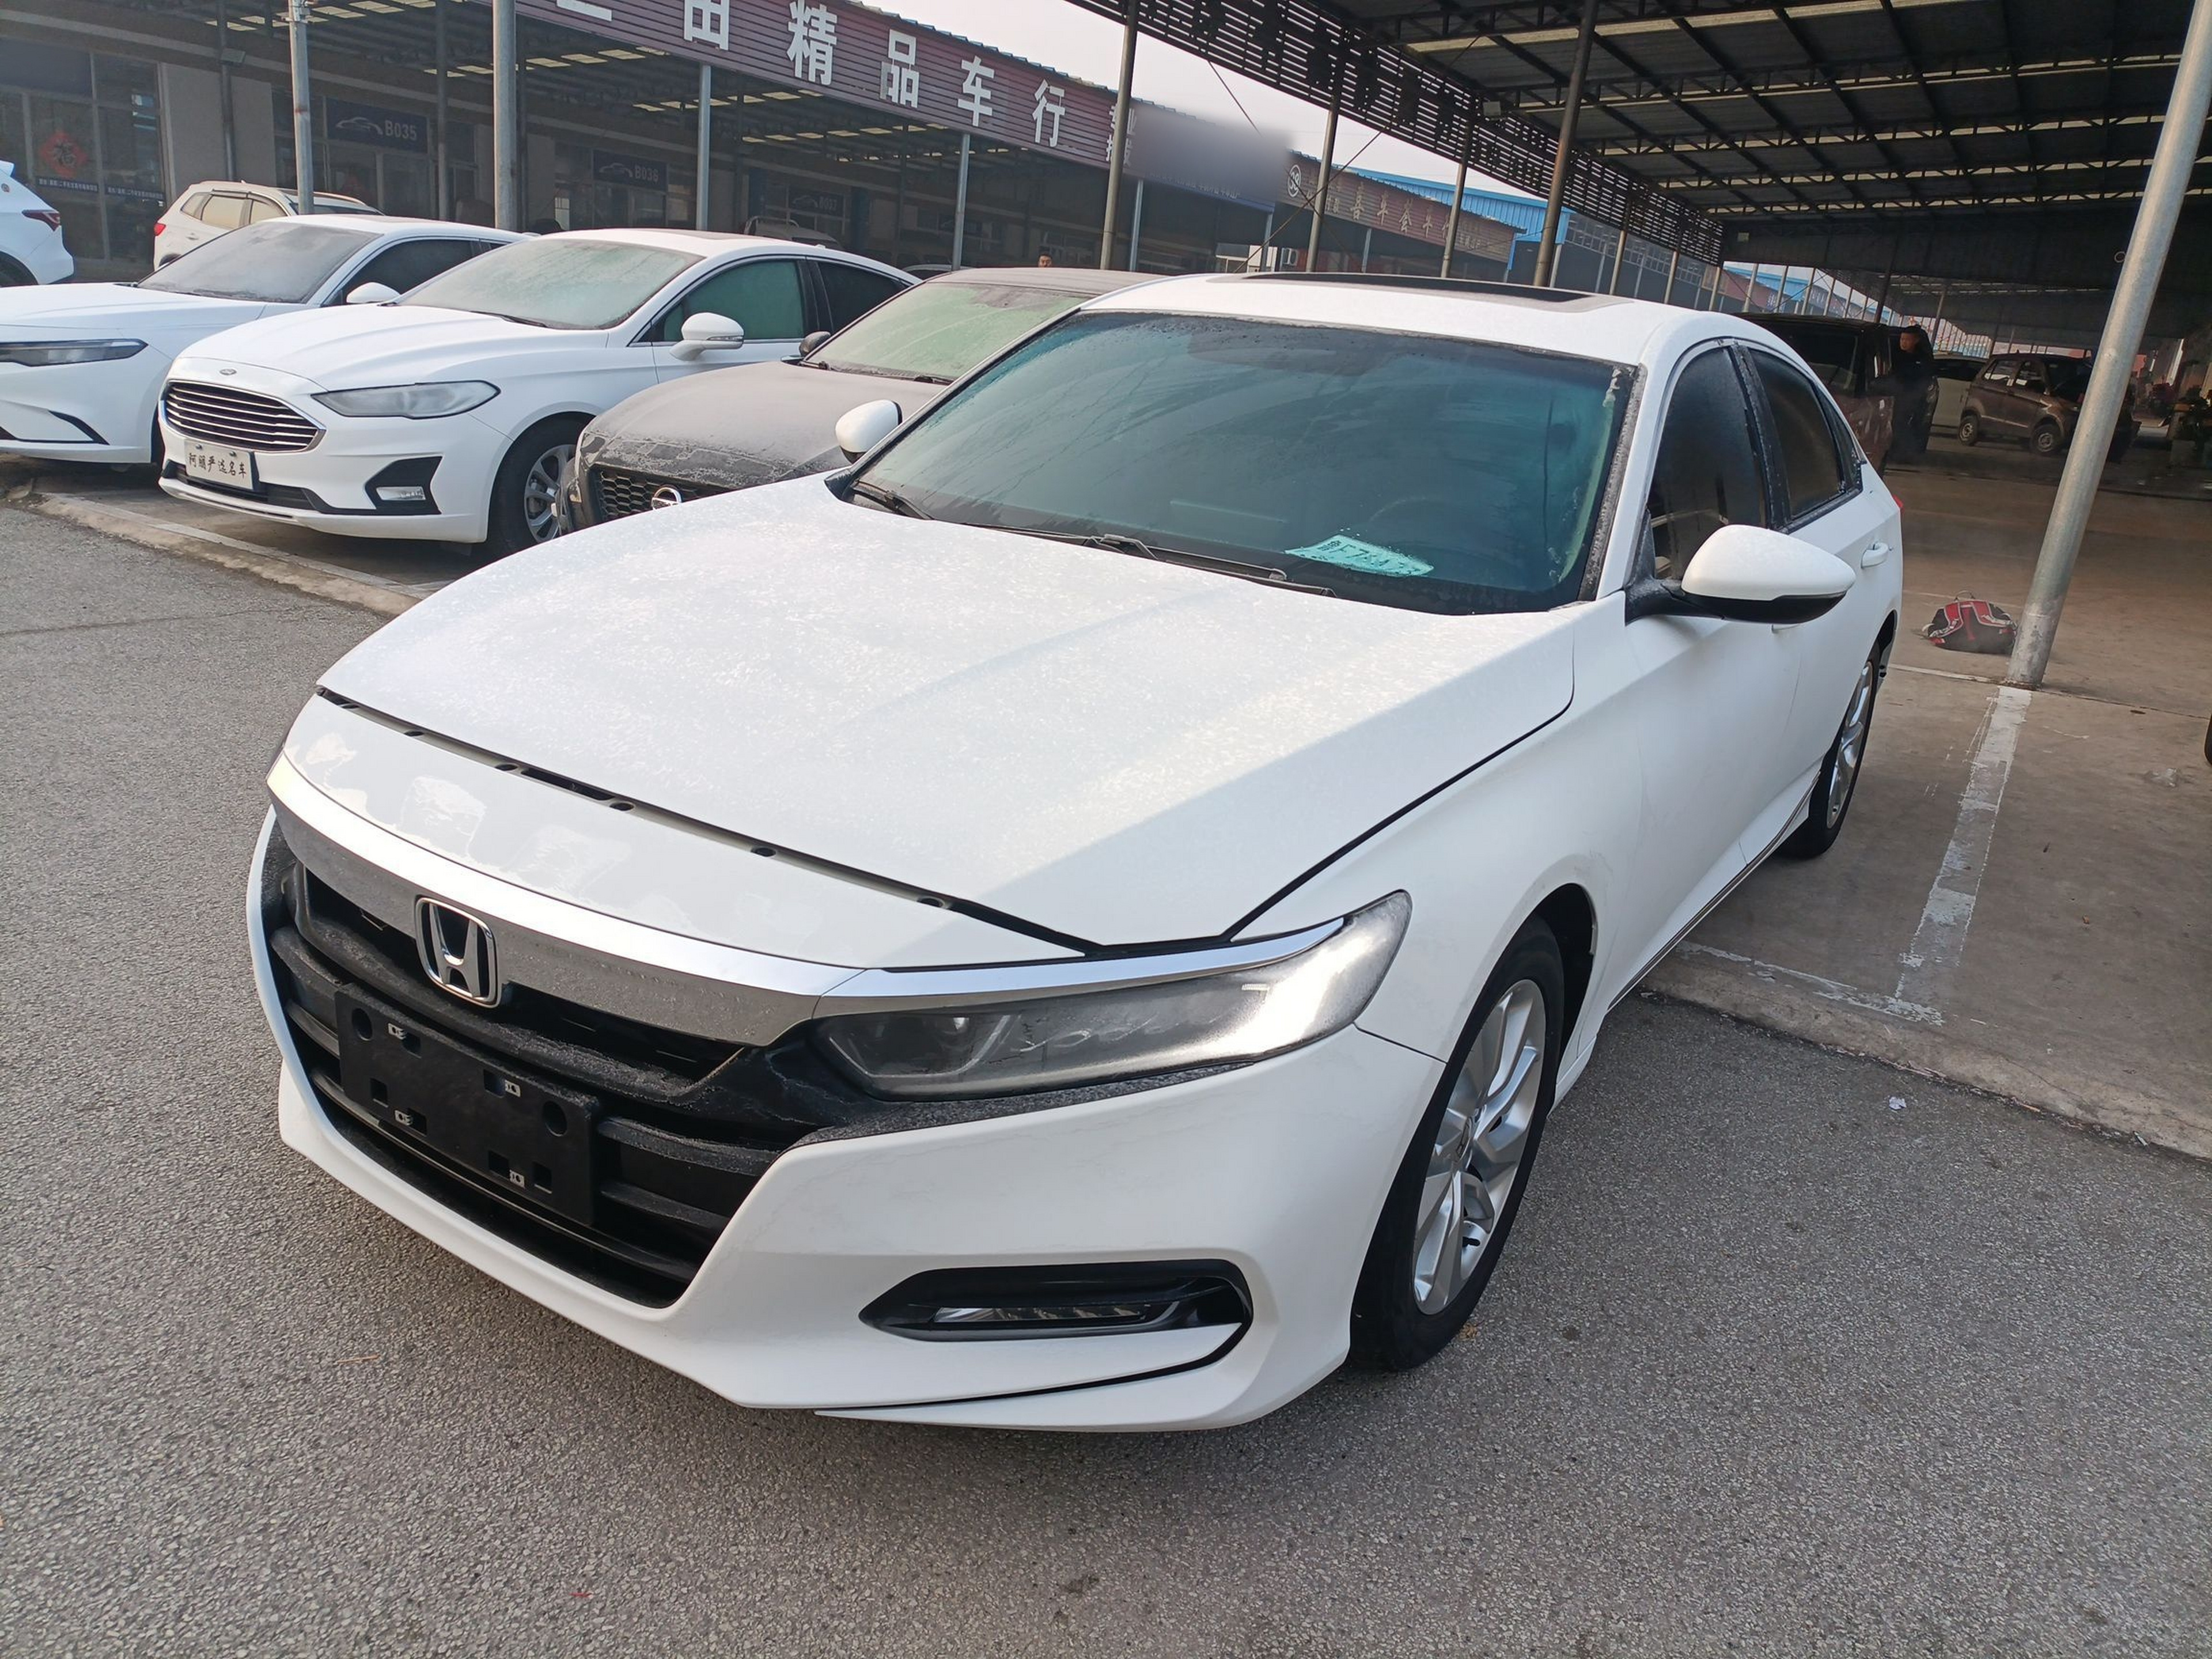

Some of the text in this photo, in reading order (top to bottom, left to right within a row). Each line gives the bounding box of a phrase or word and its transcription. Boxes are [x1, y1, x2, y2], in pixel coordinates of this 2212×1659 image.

[556, 0, 1065, 147] 田精品车行
[385, 119, 416, 141] B035
